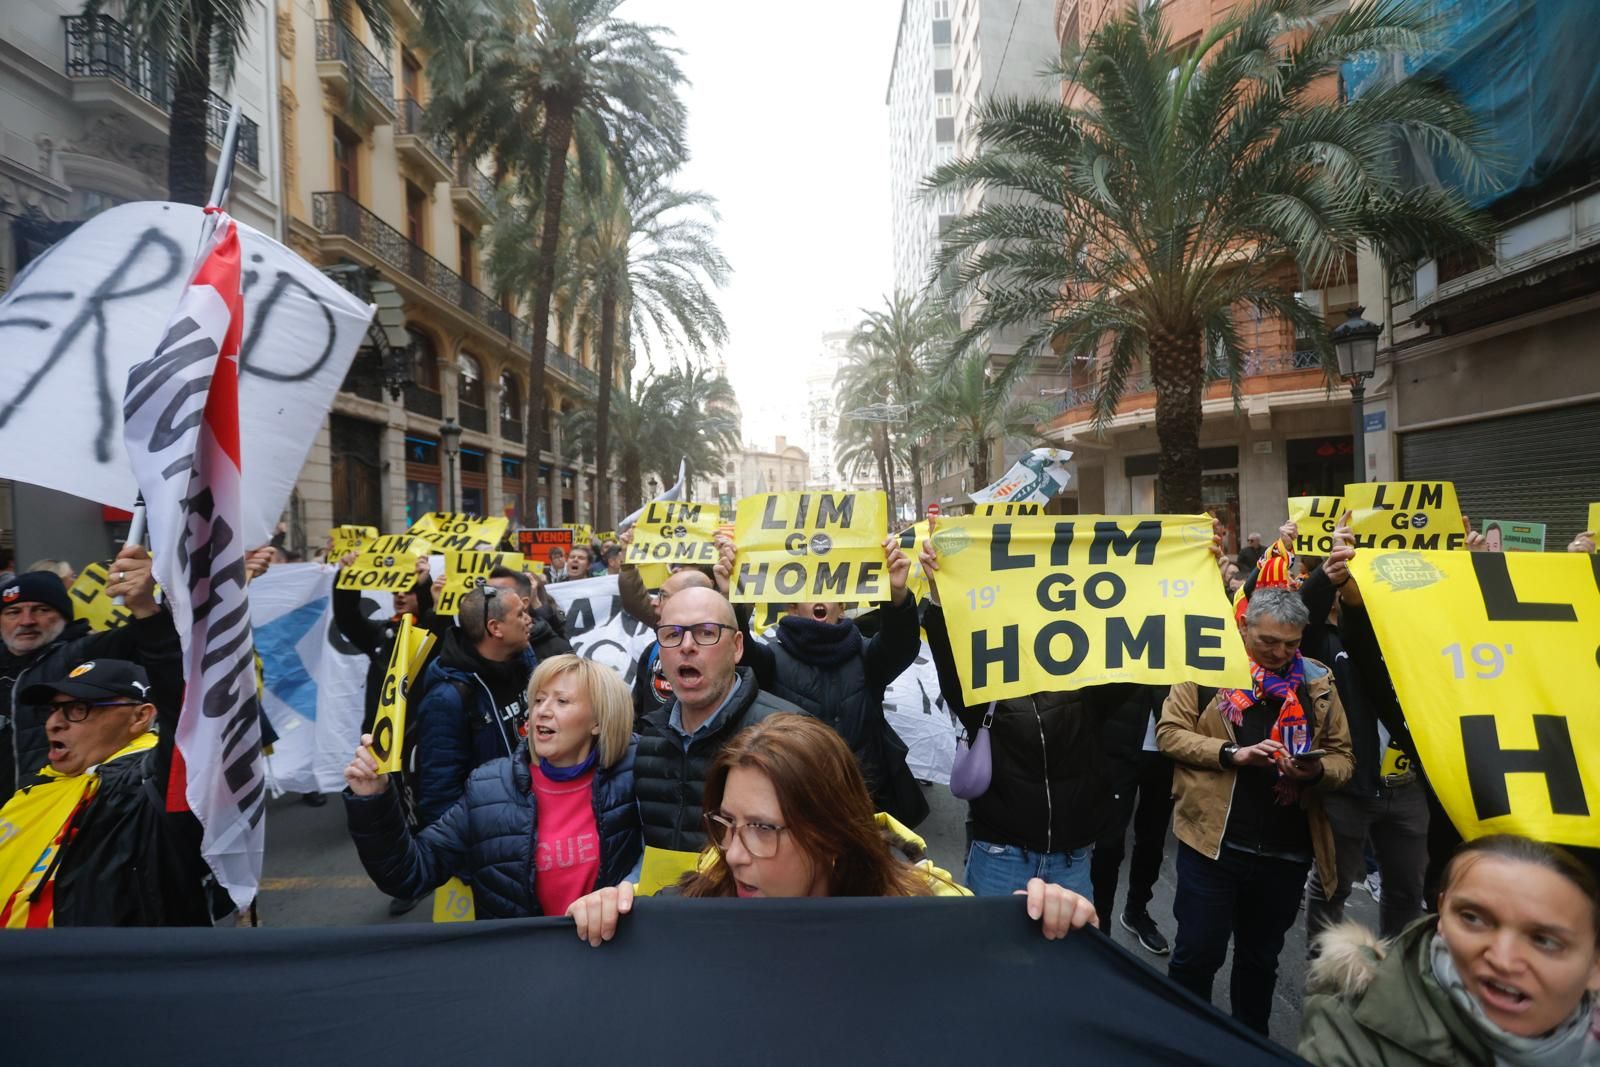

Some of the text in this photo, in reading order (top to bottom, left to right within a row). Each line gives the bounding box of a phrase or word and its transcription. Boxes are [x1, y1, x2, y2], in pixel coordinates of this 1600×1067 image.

[1309, 498, 1346, 518] LI
[1371, 483, 1444, 511] LIM
[647, 503, 702, 524] LIM
[761, 494, 856, 530] LIM
[340, 528, 368, 540] LIM
[439, 520, 470, 534] GO
[519, 531, 572, 544] SE VENDE
[367, 536, 416, 554] LIM
[629, 542, 716, 561] HOME
[990, 520, 1162, 572] LIM
[457, 552, 504, 575] LIM
[341, 569, 416, 588] HOME
[734, 561, 883, 596] HOME
[1157, 578, 1195, 599] 19'
[966, 584, 1001, 611] 19'
[1036, 571, 1127, 612] GO
[971, 614, 1226, 690] HOME
[1440, 642, 1514, 681] 19'
[535, 832, 600, 873] GUE
